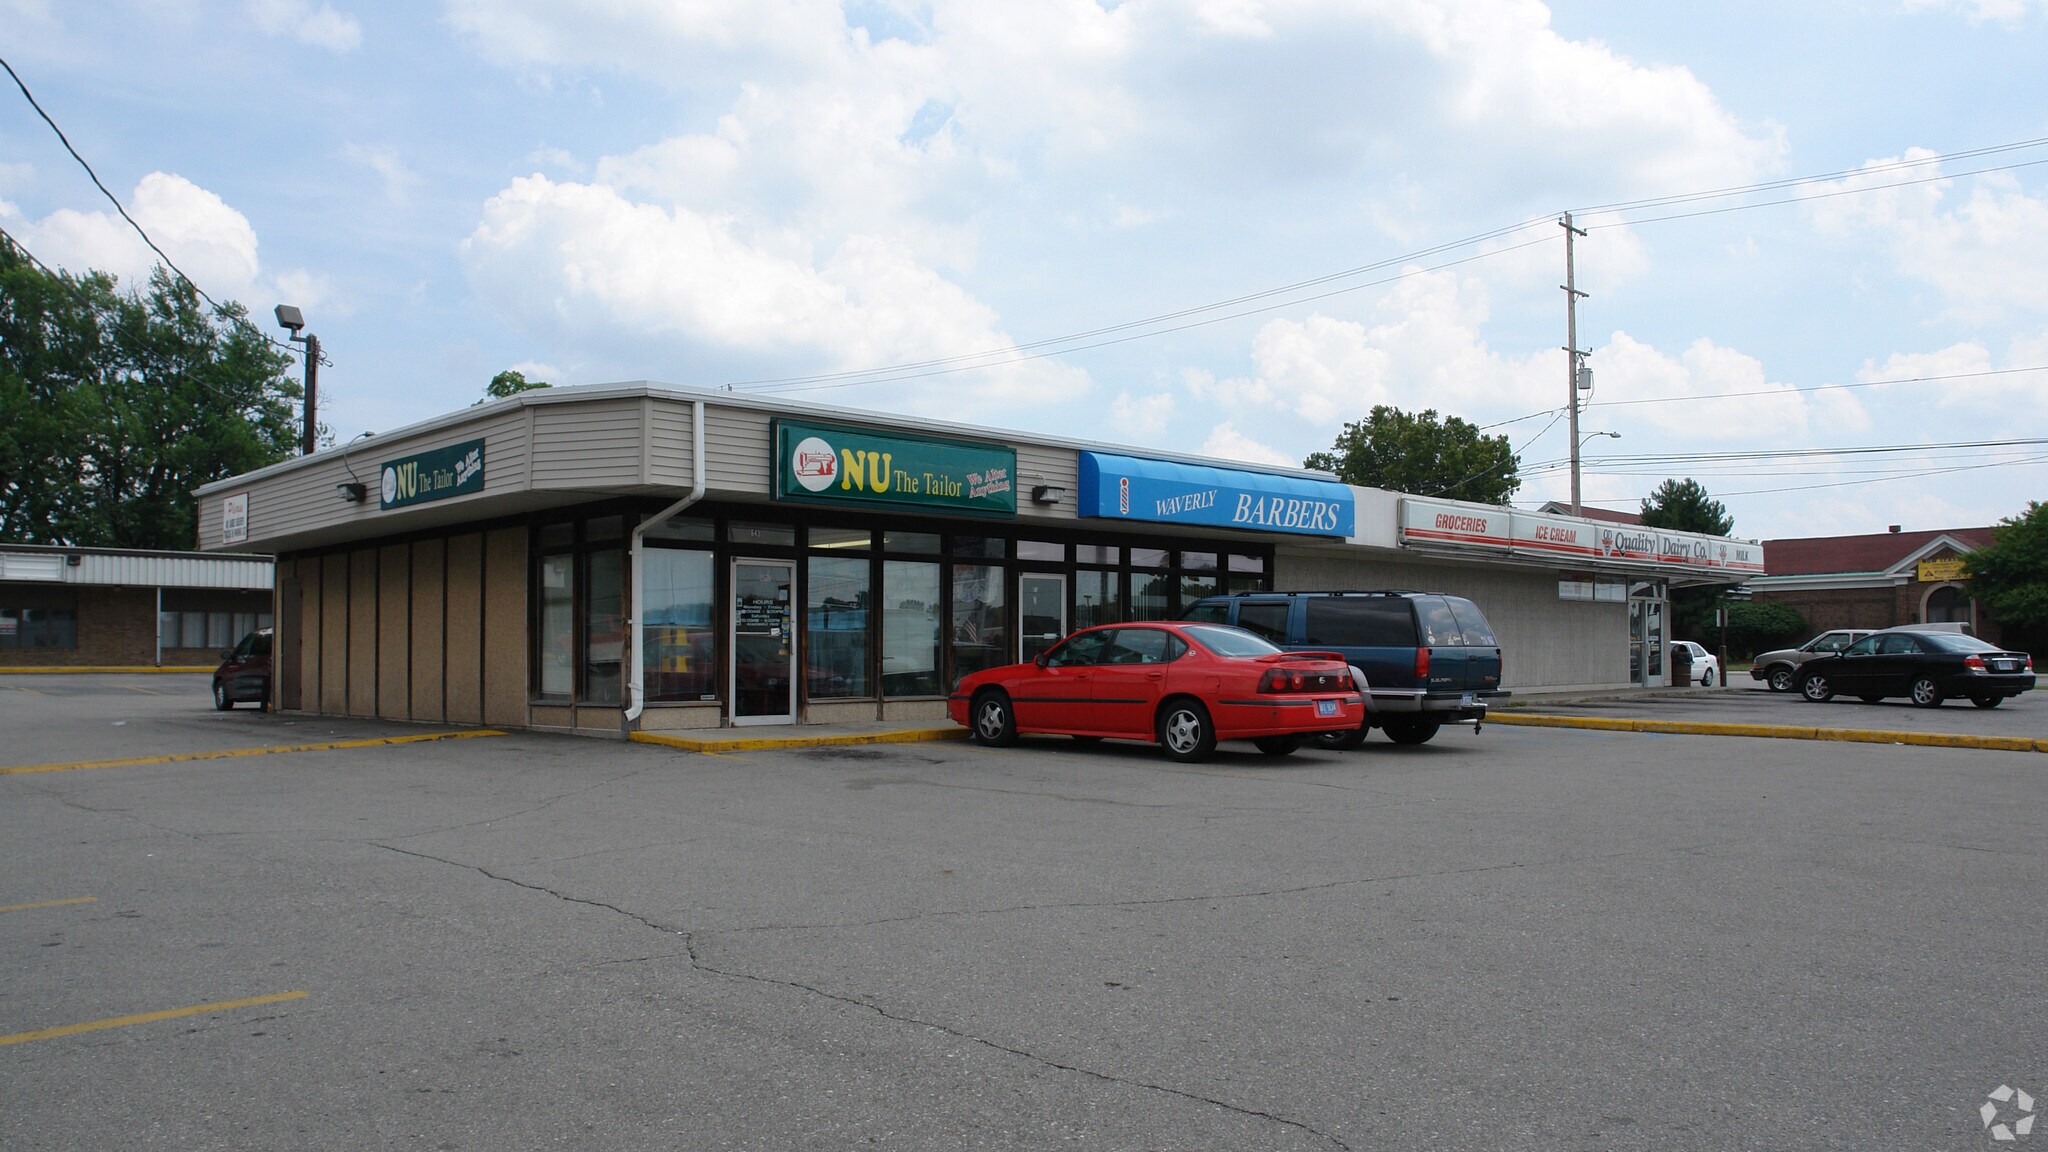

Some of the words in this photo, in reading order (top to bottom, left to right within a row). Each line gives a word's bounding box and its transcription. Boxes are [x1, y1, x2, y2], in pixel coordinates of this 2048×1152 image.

[396, 461, 418, 500] NU
[419, 473, 431, 493] The
[433, 469, 453, 490] Tailor
[841, 448, 892, 493] NU
[894, 470, 918, 493] The
[924, 473, 962, 497] Tailor
[969, 480, 1010, 498] Anything
[1156, 489, 1218, 517] WAVERLY
[1232, 493, 1340, 531] BARBERS
[1435, 513, 1487, 534] GROCERIES
[1535, 525, 1548, 541] ICE
[1550, 527, 1577, 544] CREAM
[1615, 532, 1655, 557] Quality
[1663, 537, 1690, 559] Dairy
[1694, 541, 1707, 559] Co.
[1736, 549, 1749, 561] MILK
